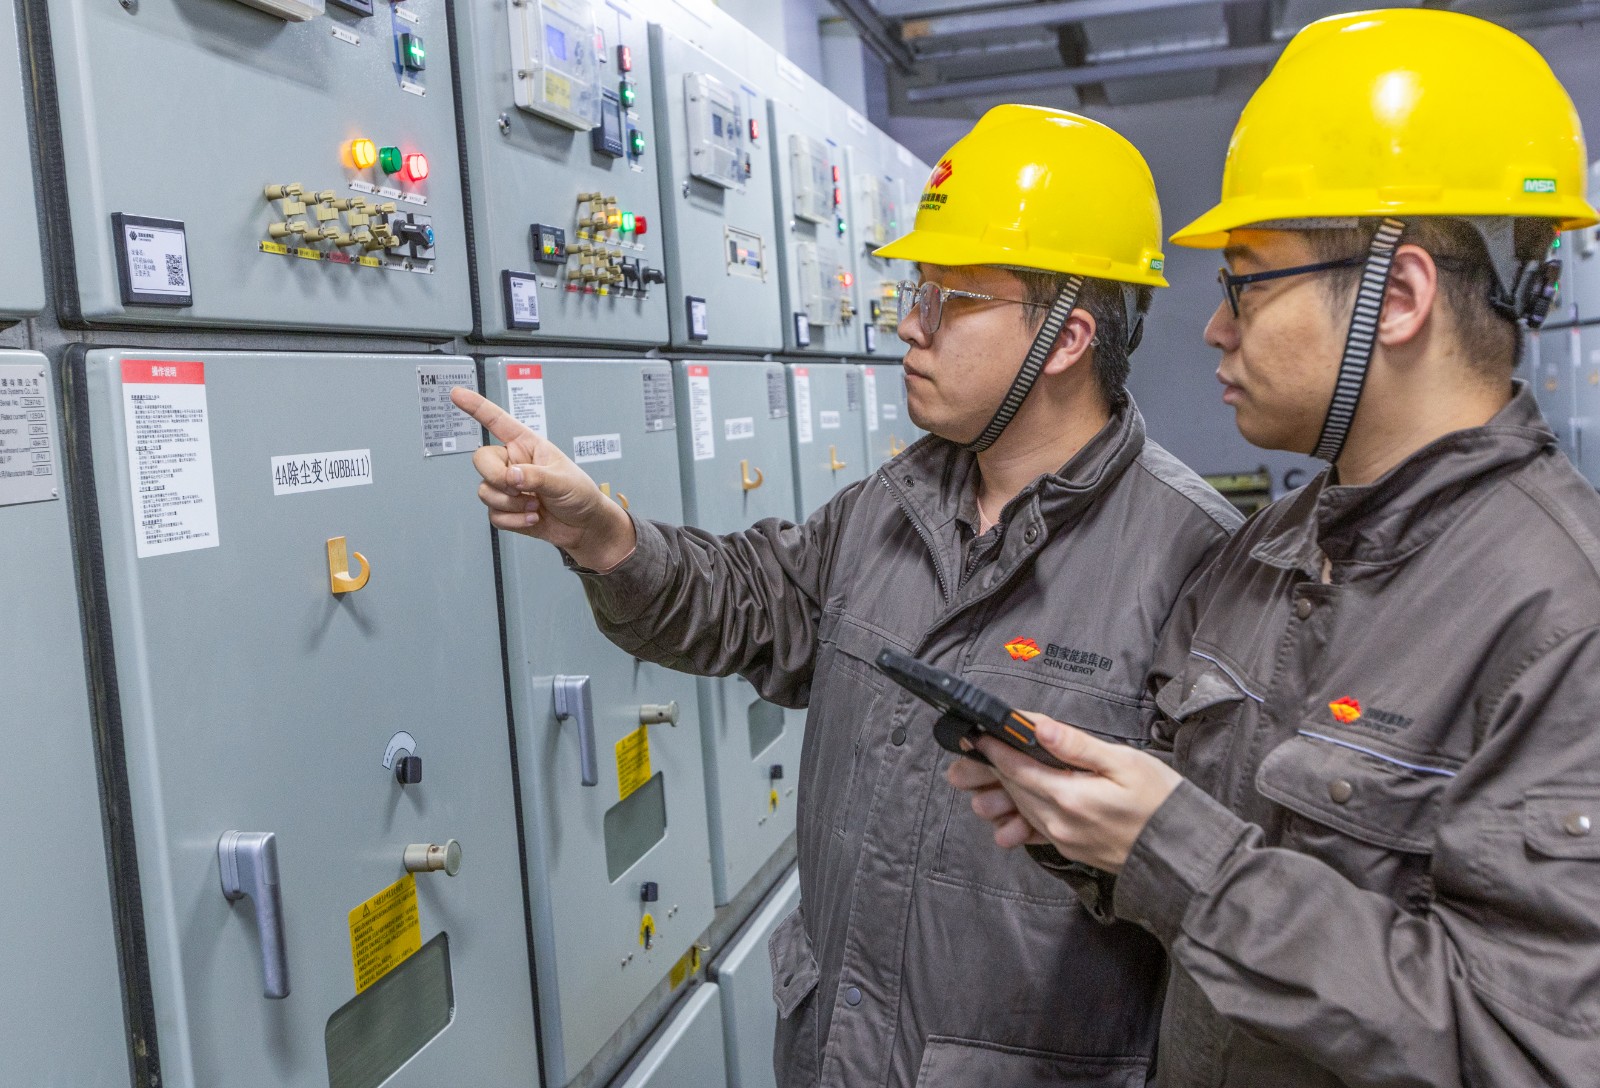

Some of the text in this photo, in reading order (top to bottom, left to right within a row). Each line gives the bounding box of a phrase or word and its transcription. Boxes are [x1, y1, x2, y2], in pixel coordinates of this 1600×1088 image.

[1525, 179, 1556, 192] MSA
[1046, 643, 1113, 672] 国家能源集团
[1043, 658, 1096, 676] CHN ENERGY
